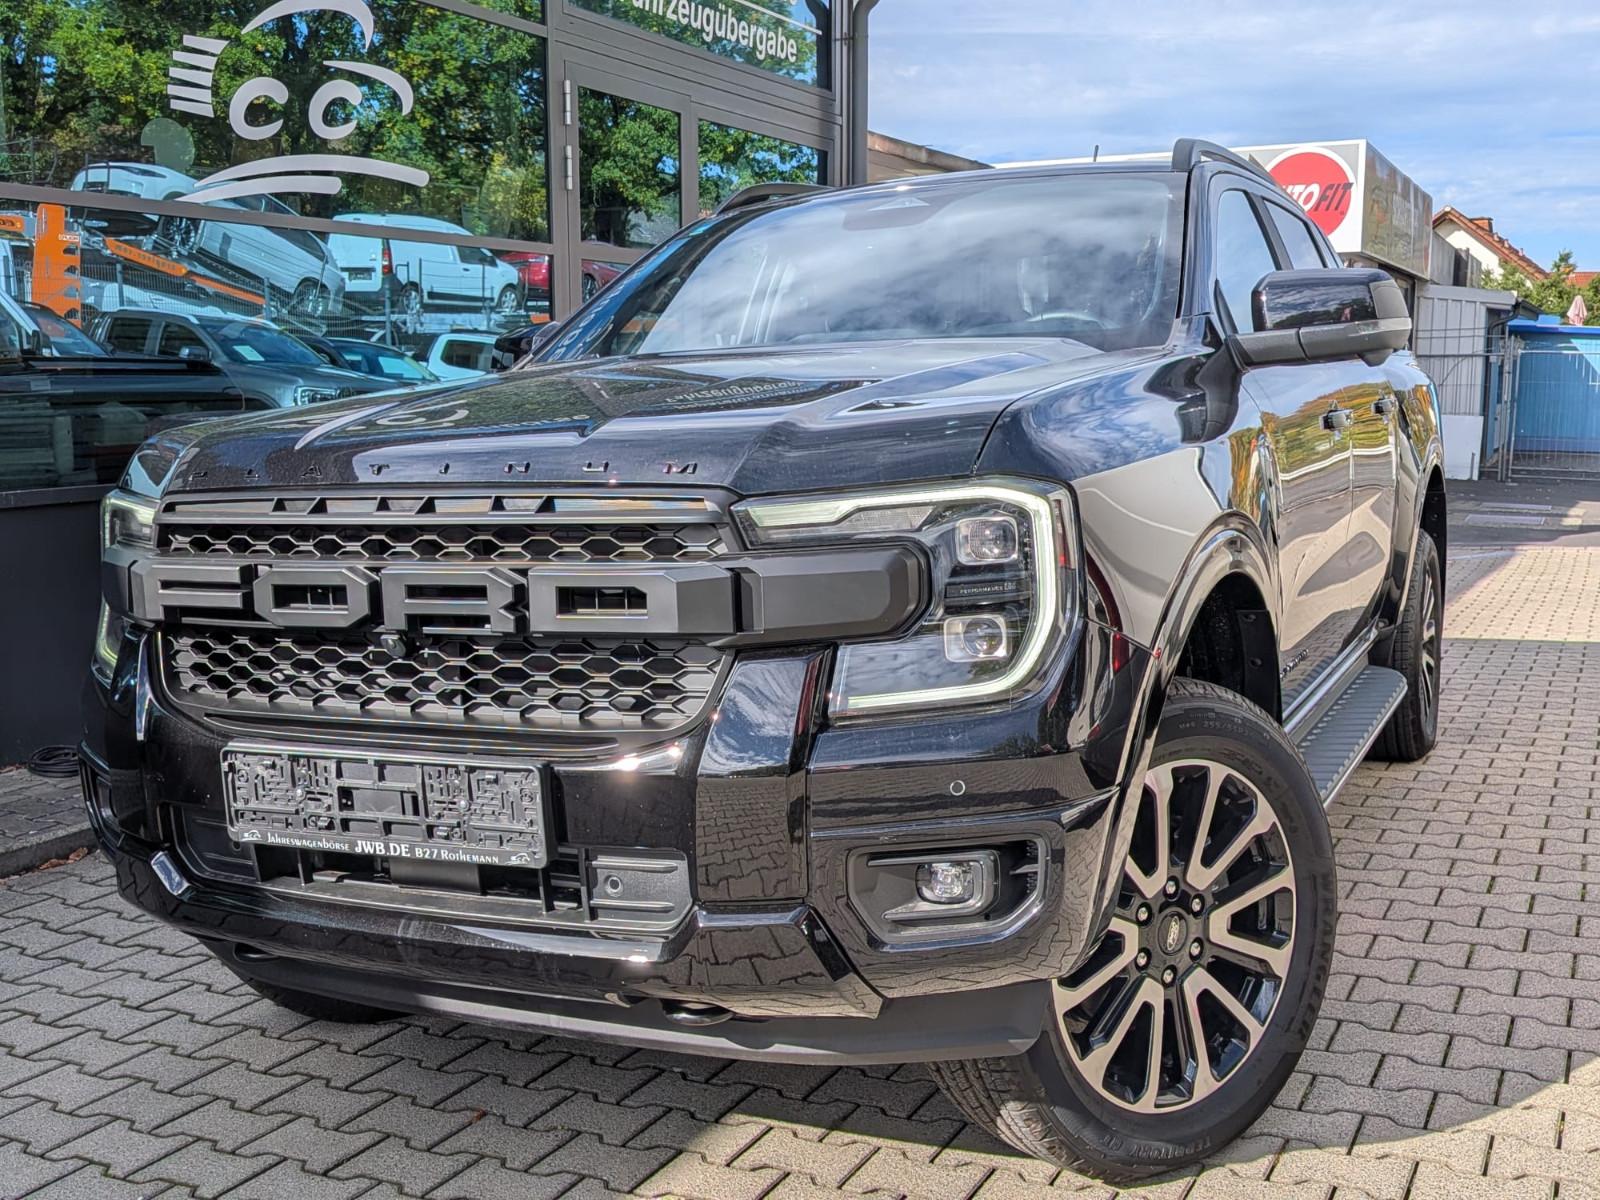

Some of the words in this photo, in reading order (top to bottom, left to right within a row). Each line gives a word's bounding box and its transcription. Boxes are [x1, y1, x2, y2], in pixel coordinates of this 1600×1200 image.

[1282, 182, 1354, 211] TOFIT
[187, 459, 699, 482] PLATINUM
[132, 564, 736, 634] FORD
[354, 840, 411, 857] JWB.DE
[415, 847, 438, 859] B27
